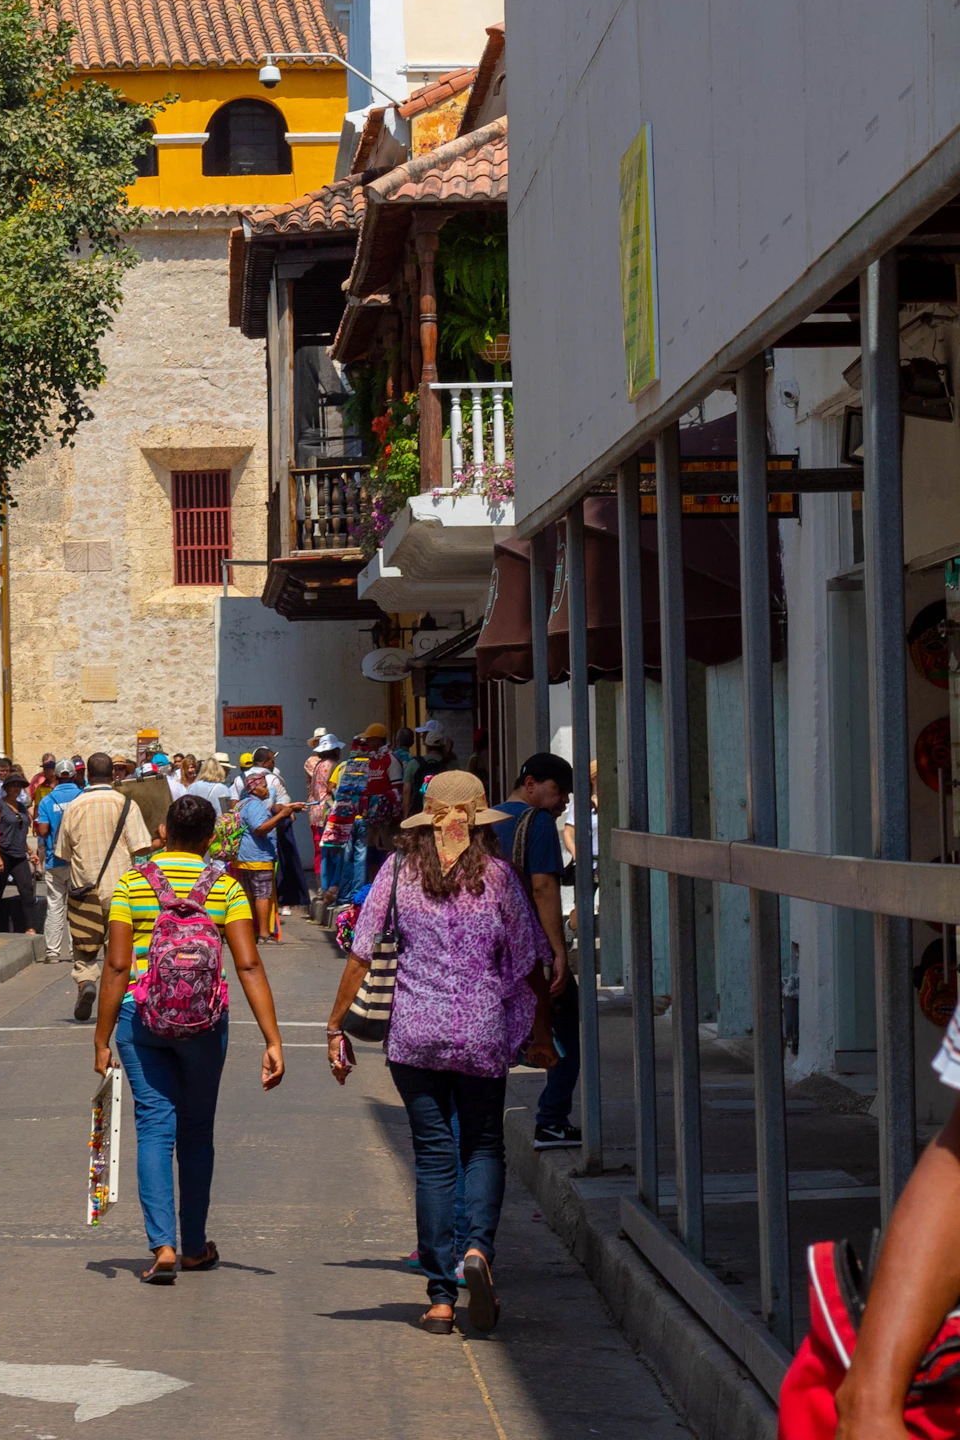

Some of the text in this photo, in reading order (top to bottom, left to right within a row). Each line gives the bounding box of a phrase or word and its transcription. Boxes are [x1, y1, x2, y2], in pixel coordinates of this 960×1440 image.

[227, 709, 278, 720] TRANSITAR POR
[229, 722, 279, 732] LA OTRA ACERA
